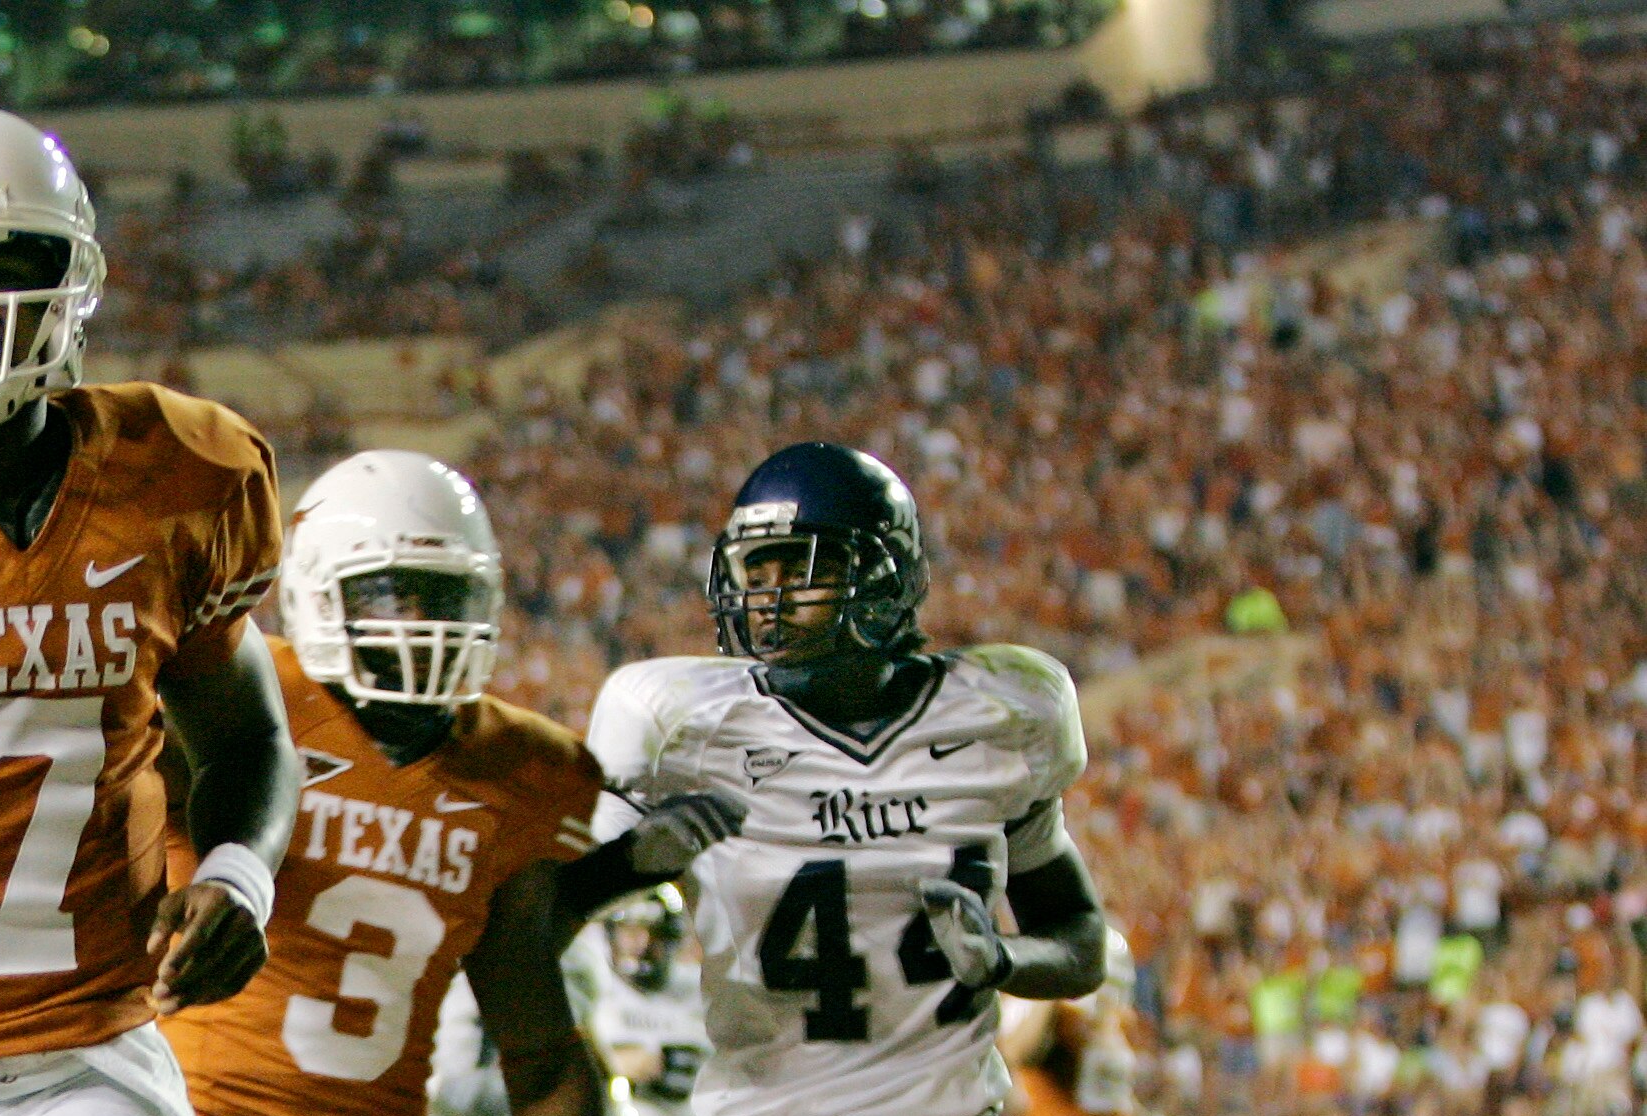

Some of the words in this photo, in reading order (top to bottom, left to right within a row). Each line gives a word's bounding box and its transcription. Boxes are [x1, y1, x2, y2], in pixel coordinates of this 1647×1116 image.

[300, 789, 479, 895] TEXAS
[809, 788, 929, 843] Rice
[281, 875, 446, 1083] 3
